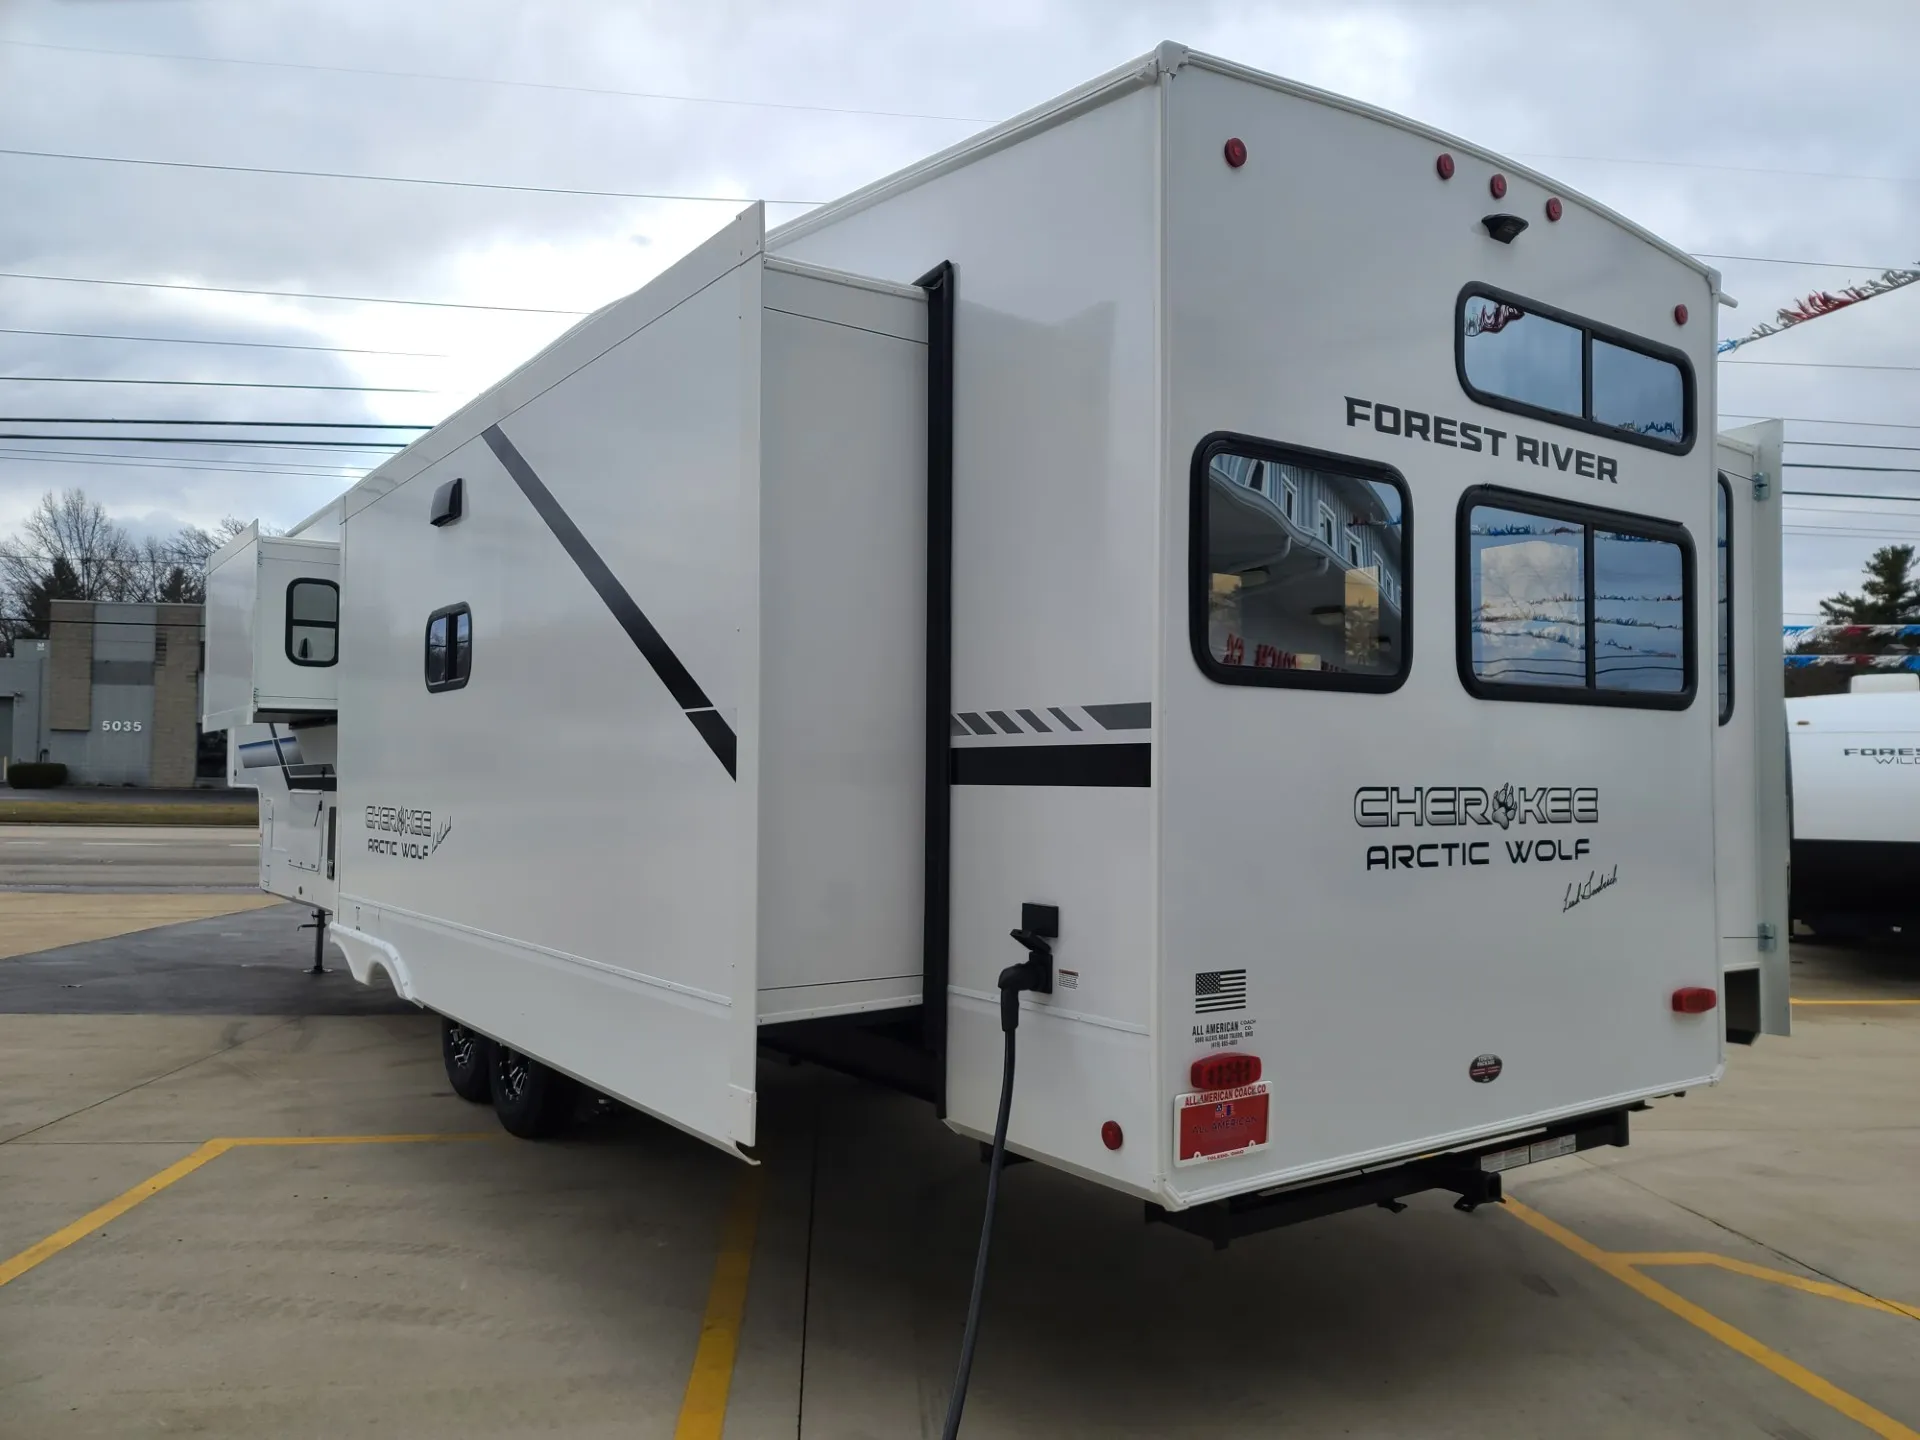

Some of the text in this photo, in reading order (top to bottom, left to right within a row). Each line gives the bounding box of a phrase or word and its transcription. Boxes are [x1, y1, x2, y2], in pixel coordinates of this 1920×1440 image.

[1344, 395, 1618, 484] FOREST RIVER
[102, 720, 142, 732] 5035
[1844, 748, 1920, 756] FORE
[368, 838, 428, 860] ARCTIC WOLF
[1367, 838, 1590, 871] ARCTIC WOLF
[1192, 1021, 1239, 1036] ALL AMERICAN
[1185, 1095, 1197, 1106] ALL
[1199, 1087, 1234, 1103] AMERICAN
[1234, 1084, 1256, 1098] COACH
